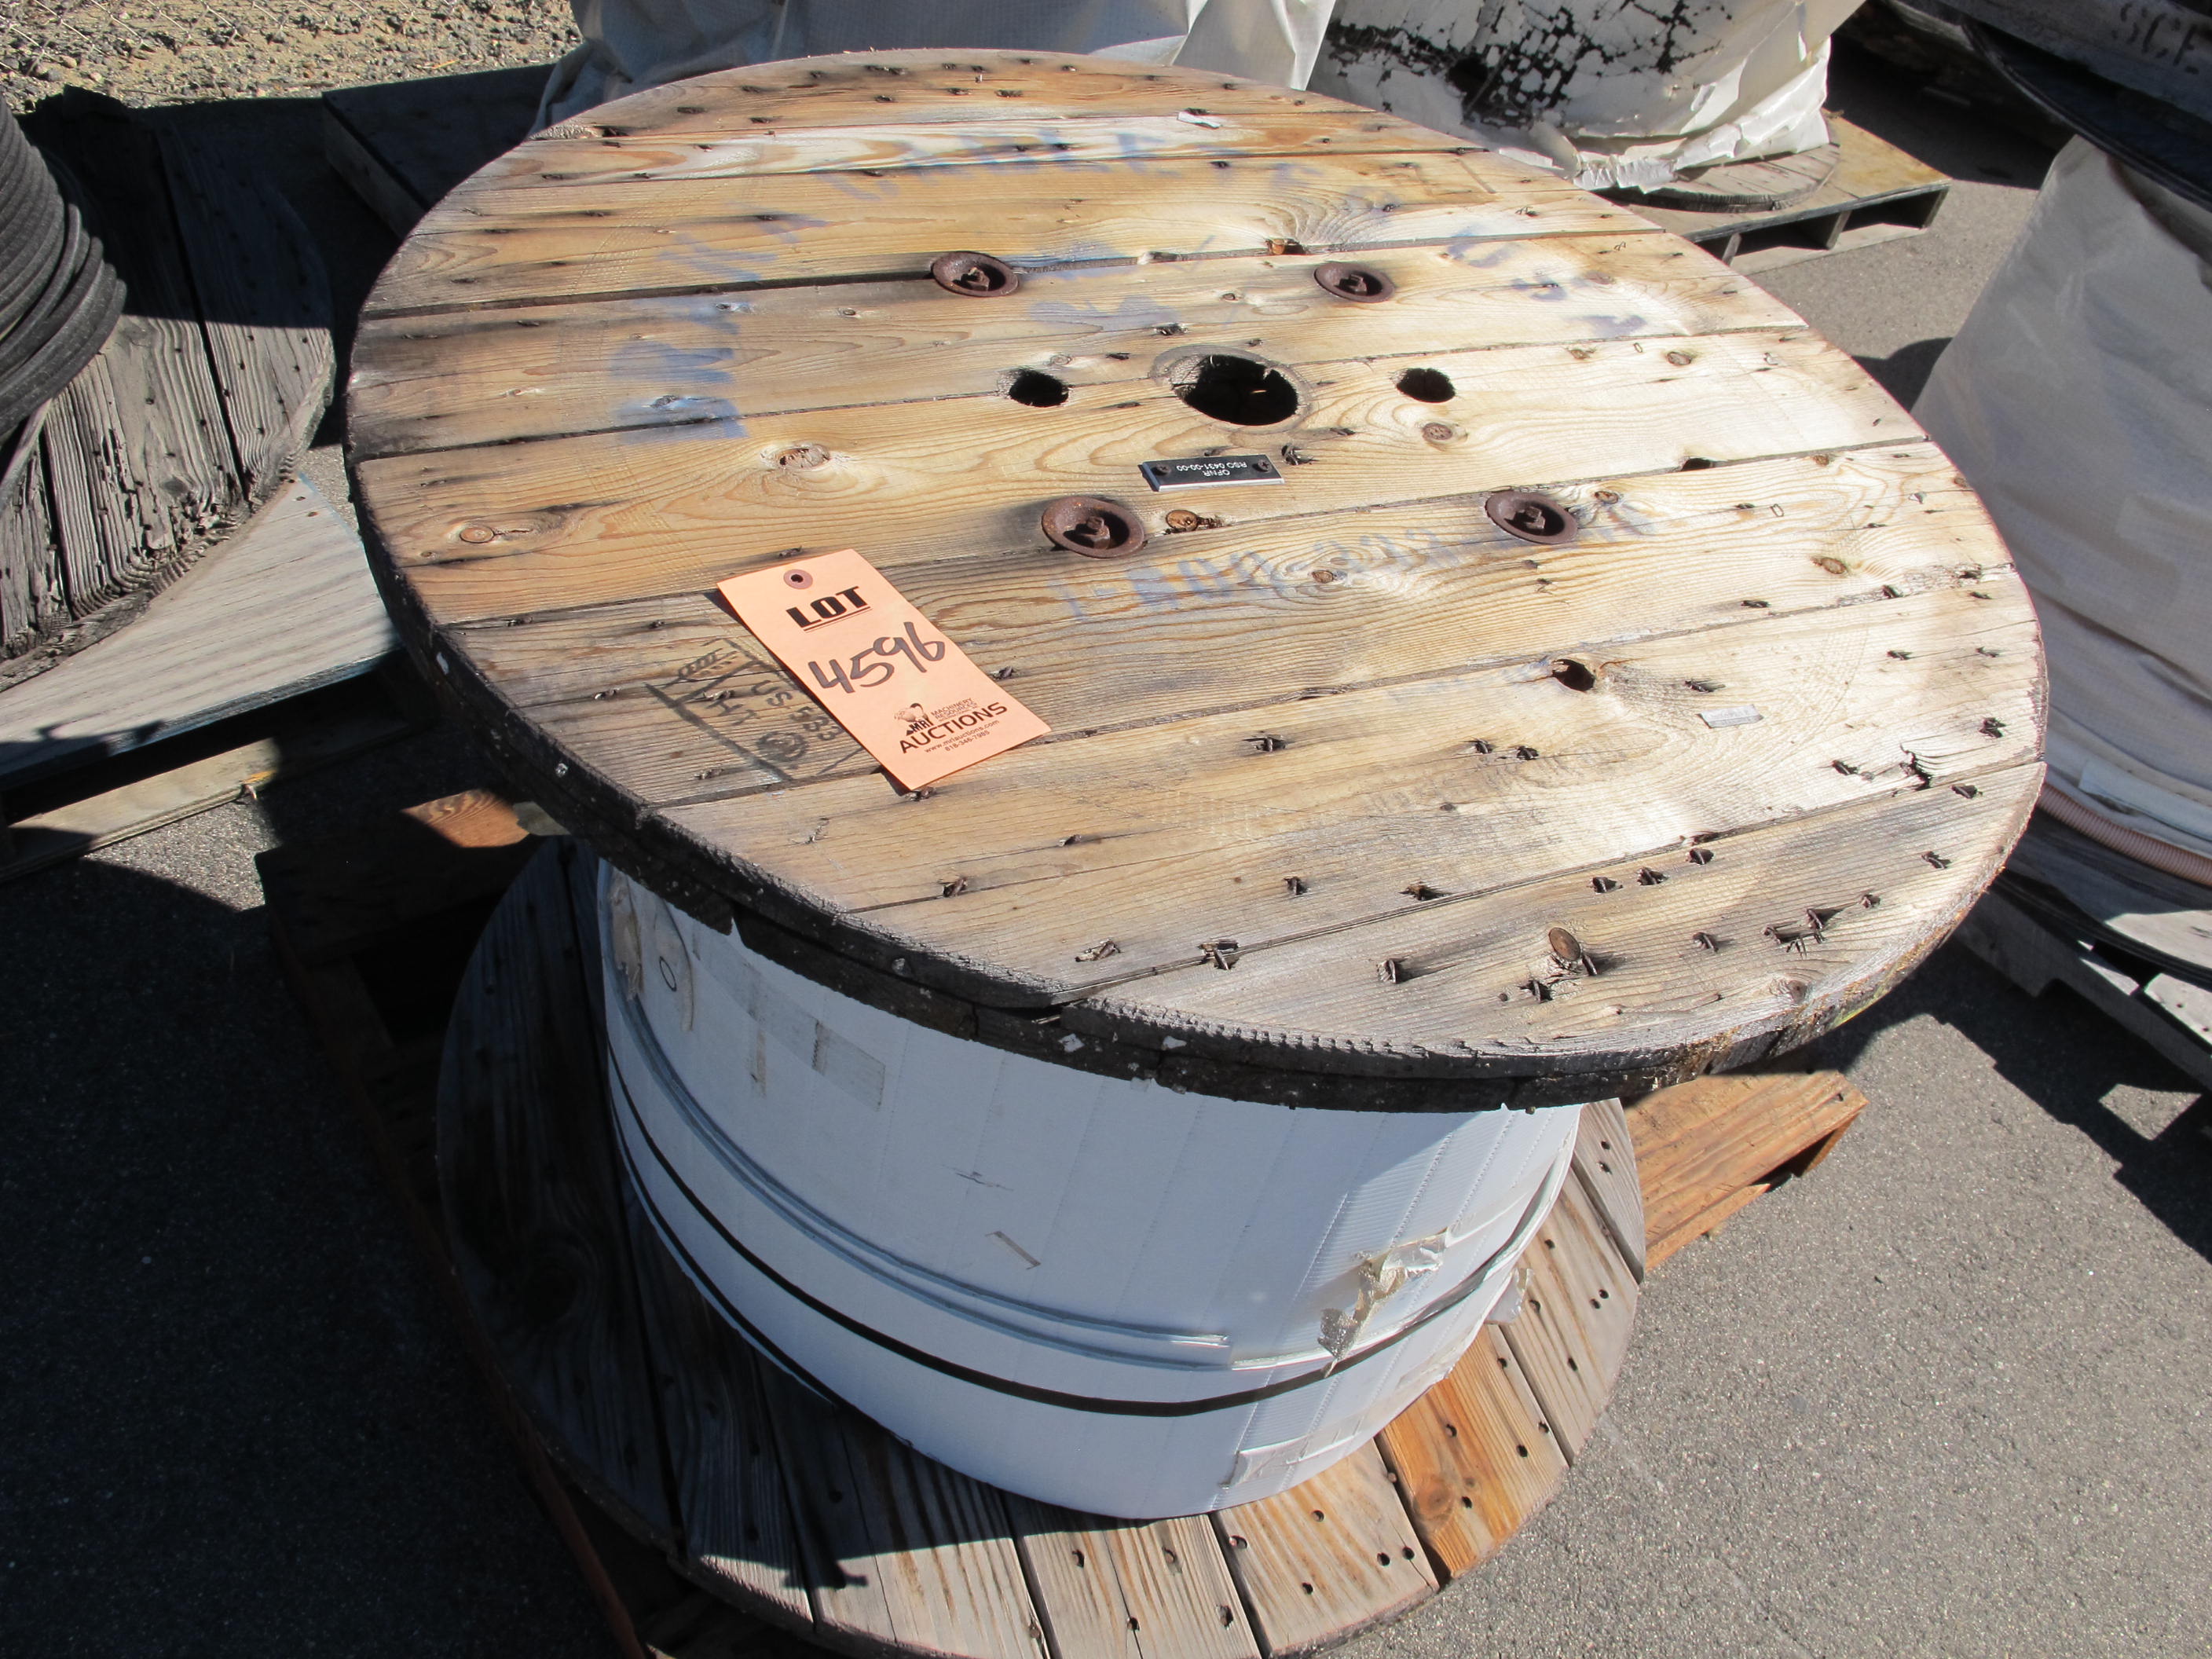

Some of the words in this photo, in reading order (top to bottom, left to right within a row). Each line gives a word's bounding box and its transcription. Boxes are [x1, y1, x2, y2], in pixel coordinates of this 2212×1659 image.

[786, 586, 868, 628] LOT
[808, 621, 945, 694] 4596
[908, 718, 934, 733] MRI
[931, 698, 972, 716] MACHINERY
[899, 701, 1008, 754] AUCTIONS
[925, 720, 1000, 753] www.mriauctions.com
